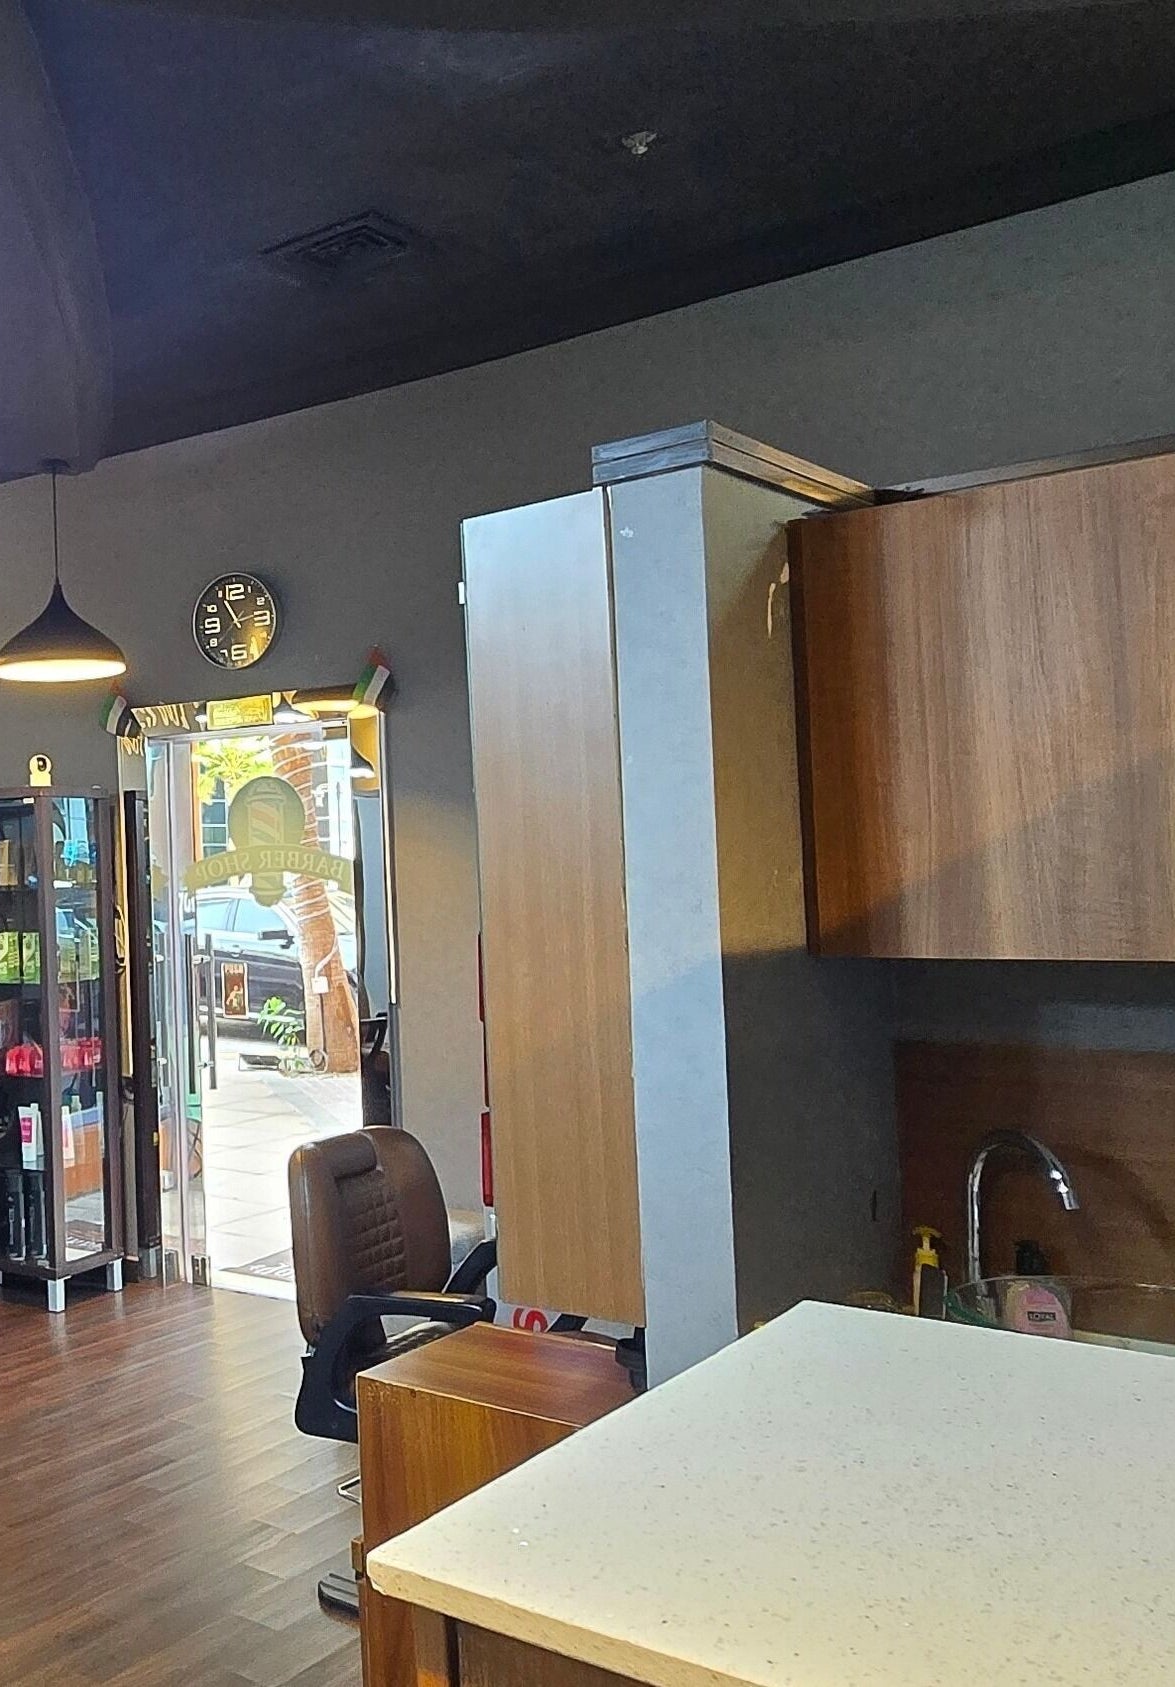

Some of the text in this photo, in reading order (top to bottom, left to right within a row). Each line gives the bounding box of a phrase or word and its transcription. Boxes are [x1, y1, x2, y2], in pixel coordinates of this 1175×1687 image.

[225, 584, 245, 601] 12
[256, 597, 265, 606] 2
[204, 617, 221, 634] 9
[253, 610, 271, 627] 3
[231, 644, 247, 660] 6
